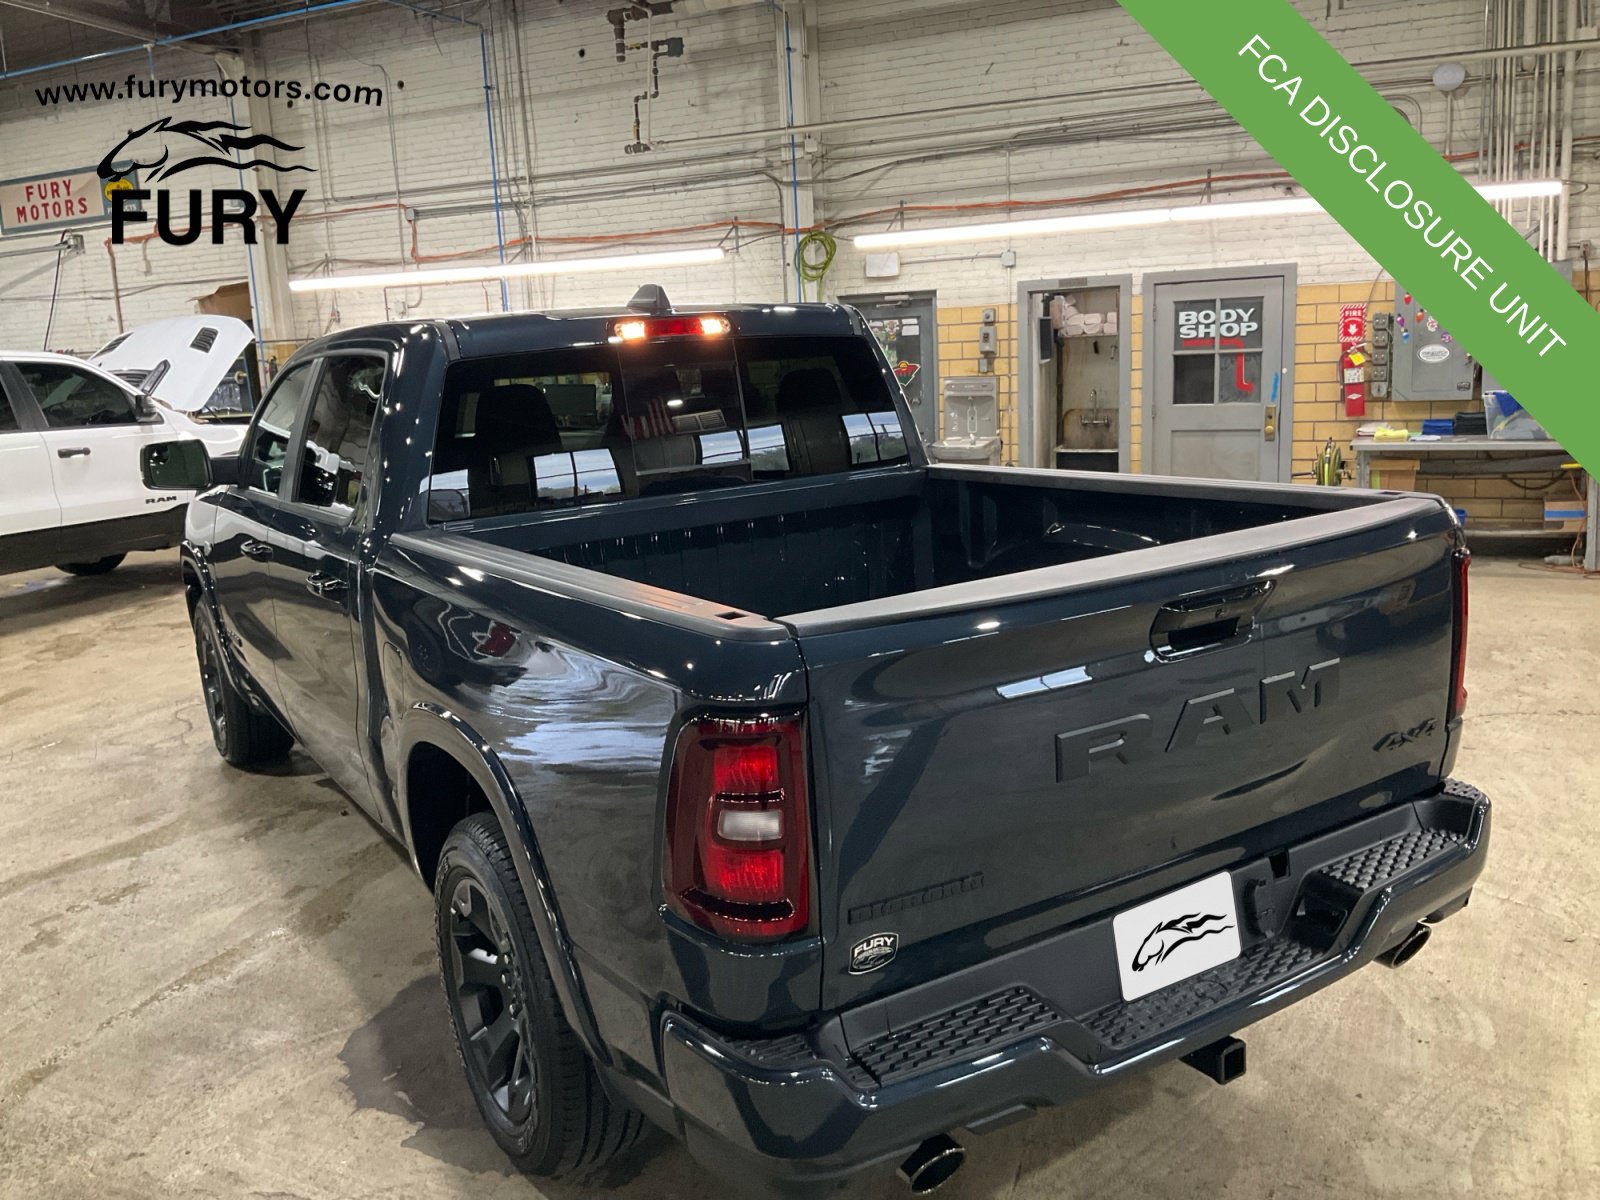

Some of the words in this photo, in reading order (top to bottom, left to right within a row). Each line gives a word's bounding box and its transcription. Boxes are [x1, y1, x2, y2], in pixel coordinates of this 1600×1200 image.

[25, 179, 72, 201] FURY
[16, 197, 89, 223] MOTORS
[1178, 308, 1256, 325] BODY
[1345, 309, 1362, 317] FIRE
[1179, 321, 1258, 339] SHOP
[145, 496, 177, 504] RAM
[1055, 657, 1341, 784] RAM
[854, 936, 894, 958] FURY
